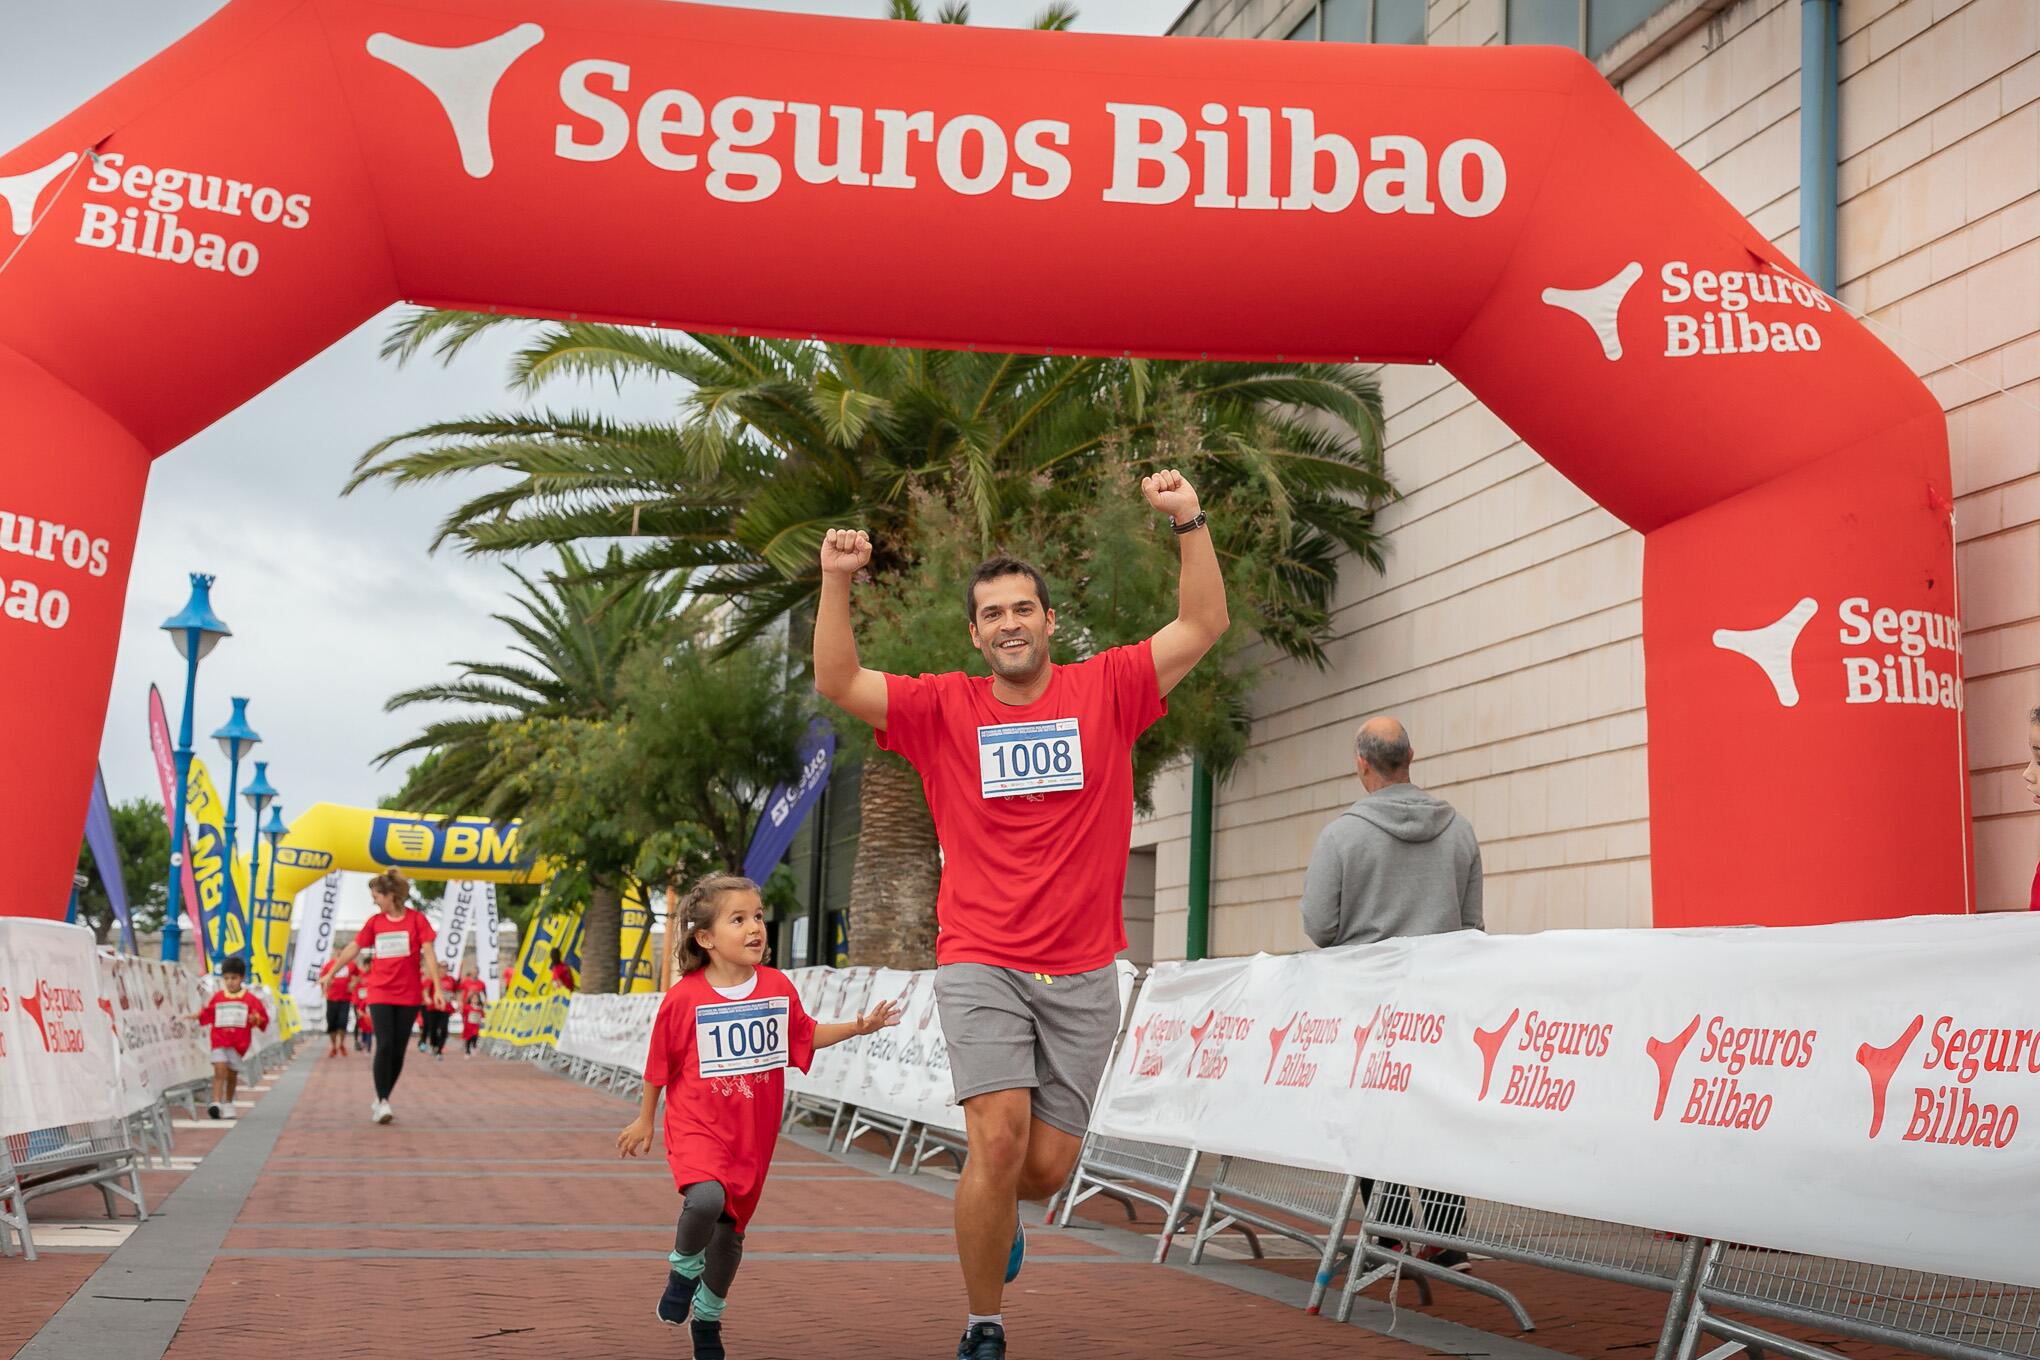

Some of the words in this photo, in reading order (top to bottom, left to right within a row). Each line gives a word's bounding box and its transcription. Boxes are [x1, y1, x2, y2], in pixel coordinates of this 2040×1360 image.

[554, 58, 1072, 203] Seguros
[1102, 102, 1507, 218] Bilbao
[87, 152, 312, 230] Seguros
[75, 202, 260, 277] Bilbao
[1661, 261, 1832, 313] Seguros
[1663, 312, 1822, 357] Bilbao
[1842, 654, 1963, 712] Bilbao
[992, 740, 1072, 778] 1008
[441, 826, 519, 864] BM
[316, 869, 341, 952] CORRE
[709, 1017, 779, 1058] 1008
[1291, 1010, 1342, 1051] Seguros
[1519, 1010, 1613, 1063] Seguros
[1701, 1016, 1817, 1075] Seguros
[1275, 1053, 1318, 1089] Bilbao
[1361, 1051, 1412, 1093] Bilbao
[1500, 1065, 1576, 1112] Bilbao
[1680, 1078, 1774, 1131] Bilbao
[1902, 1086, 2019, 1148] Bilbao
